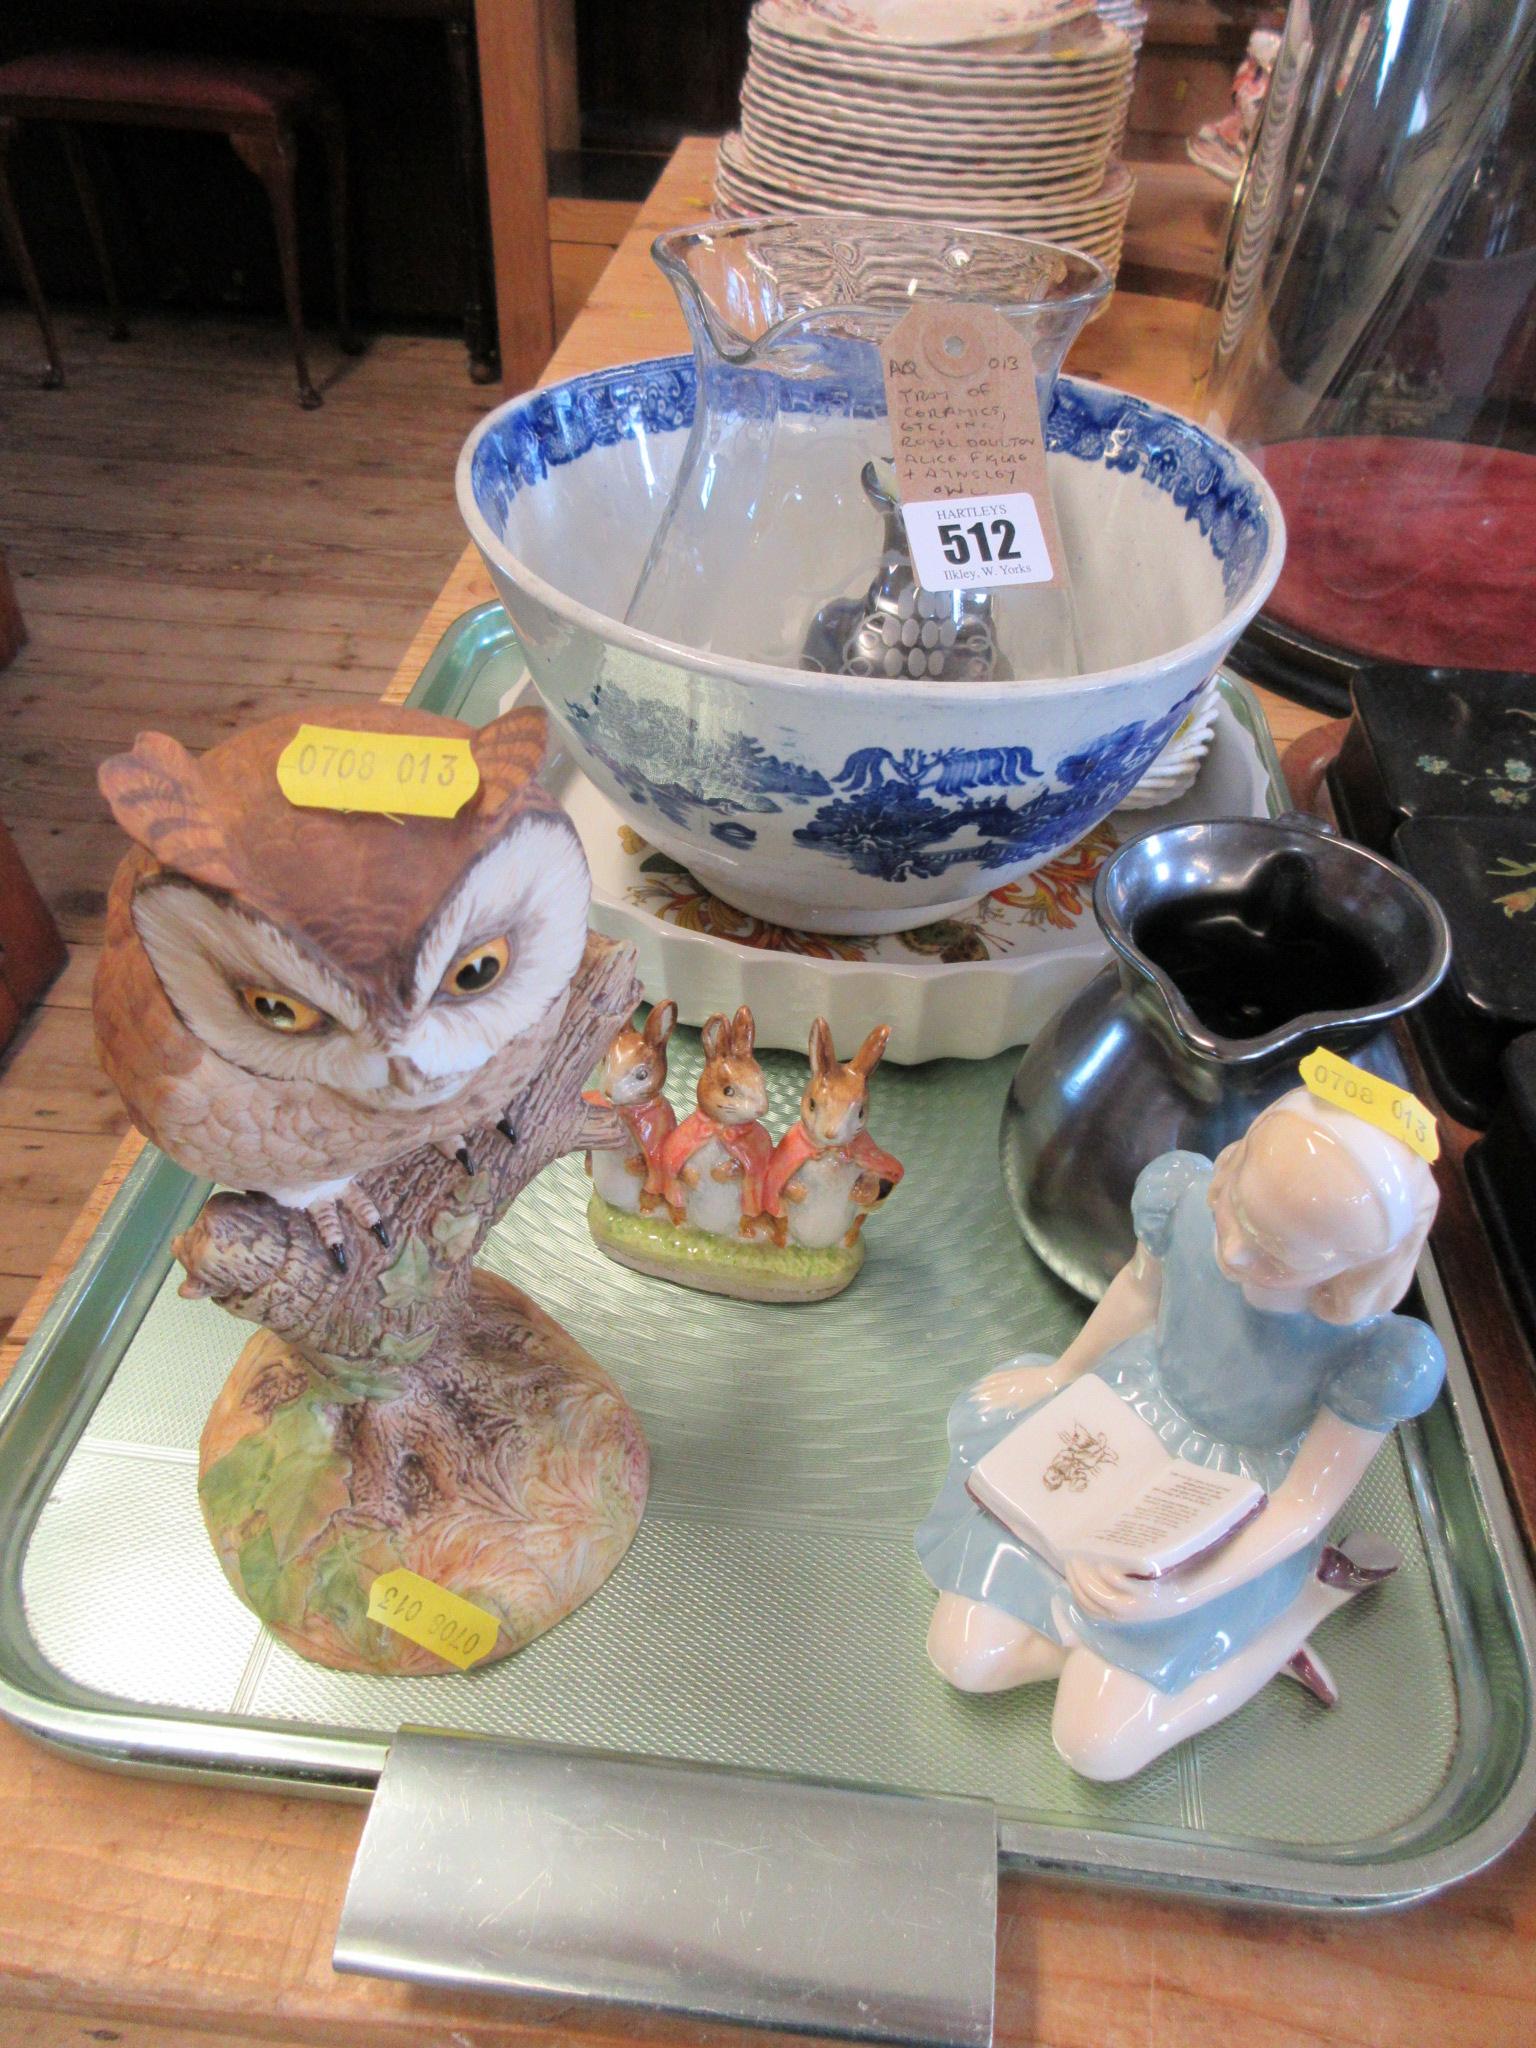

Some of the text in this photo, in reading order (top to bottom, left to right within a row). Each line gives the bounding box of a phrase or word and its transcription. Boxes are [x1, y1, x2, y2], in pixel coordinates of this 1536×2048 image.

[988, 355, 1020, 371] 013
[967, 382, 991, 397] OF
[966, 436, 1035, 448] DOULTON
[904, 454, 957, 465] ALICE
[903, 468, 916, 480] +
[936, 504, 1008, 521] HARTLEYS
[937, 519, 1022, 566] 512
[943, 563, 1032, 581] Ilkley, W. Yorks
[298, 744, 458, 787] 0708 013
[1314, 1065, 1427, 1143] 0708 013
[377, 1586, 481, 1656] 0708 013
